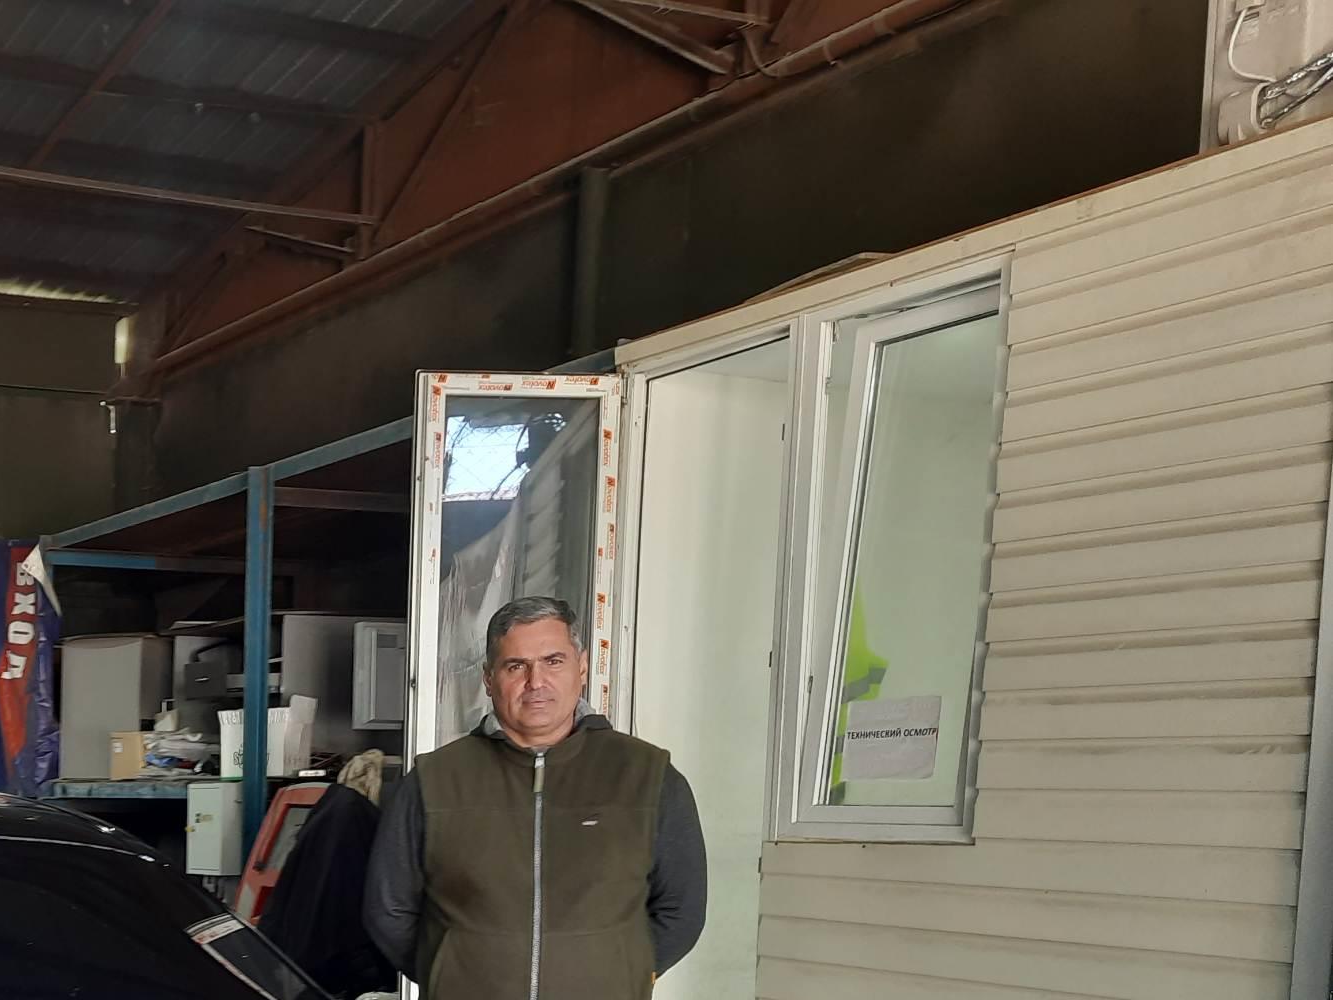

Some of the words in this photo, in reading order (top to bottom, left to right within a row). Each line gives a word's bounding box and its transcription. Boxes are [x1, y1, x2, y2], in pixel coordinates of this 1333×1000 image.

[522, 378, 556, 390] Novotex
[602, 429, 612, 465] Novotex
[847, 728, 901, 740] ТЕХНИЧЕСКИЙ
[903, 727, 937, 738] ОСМОТР
